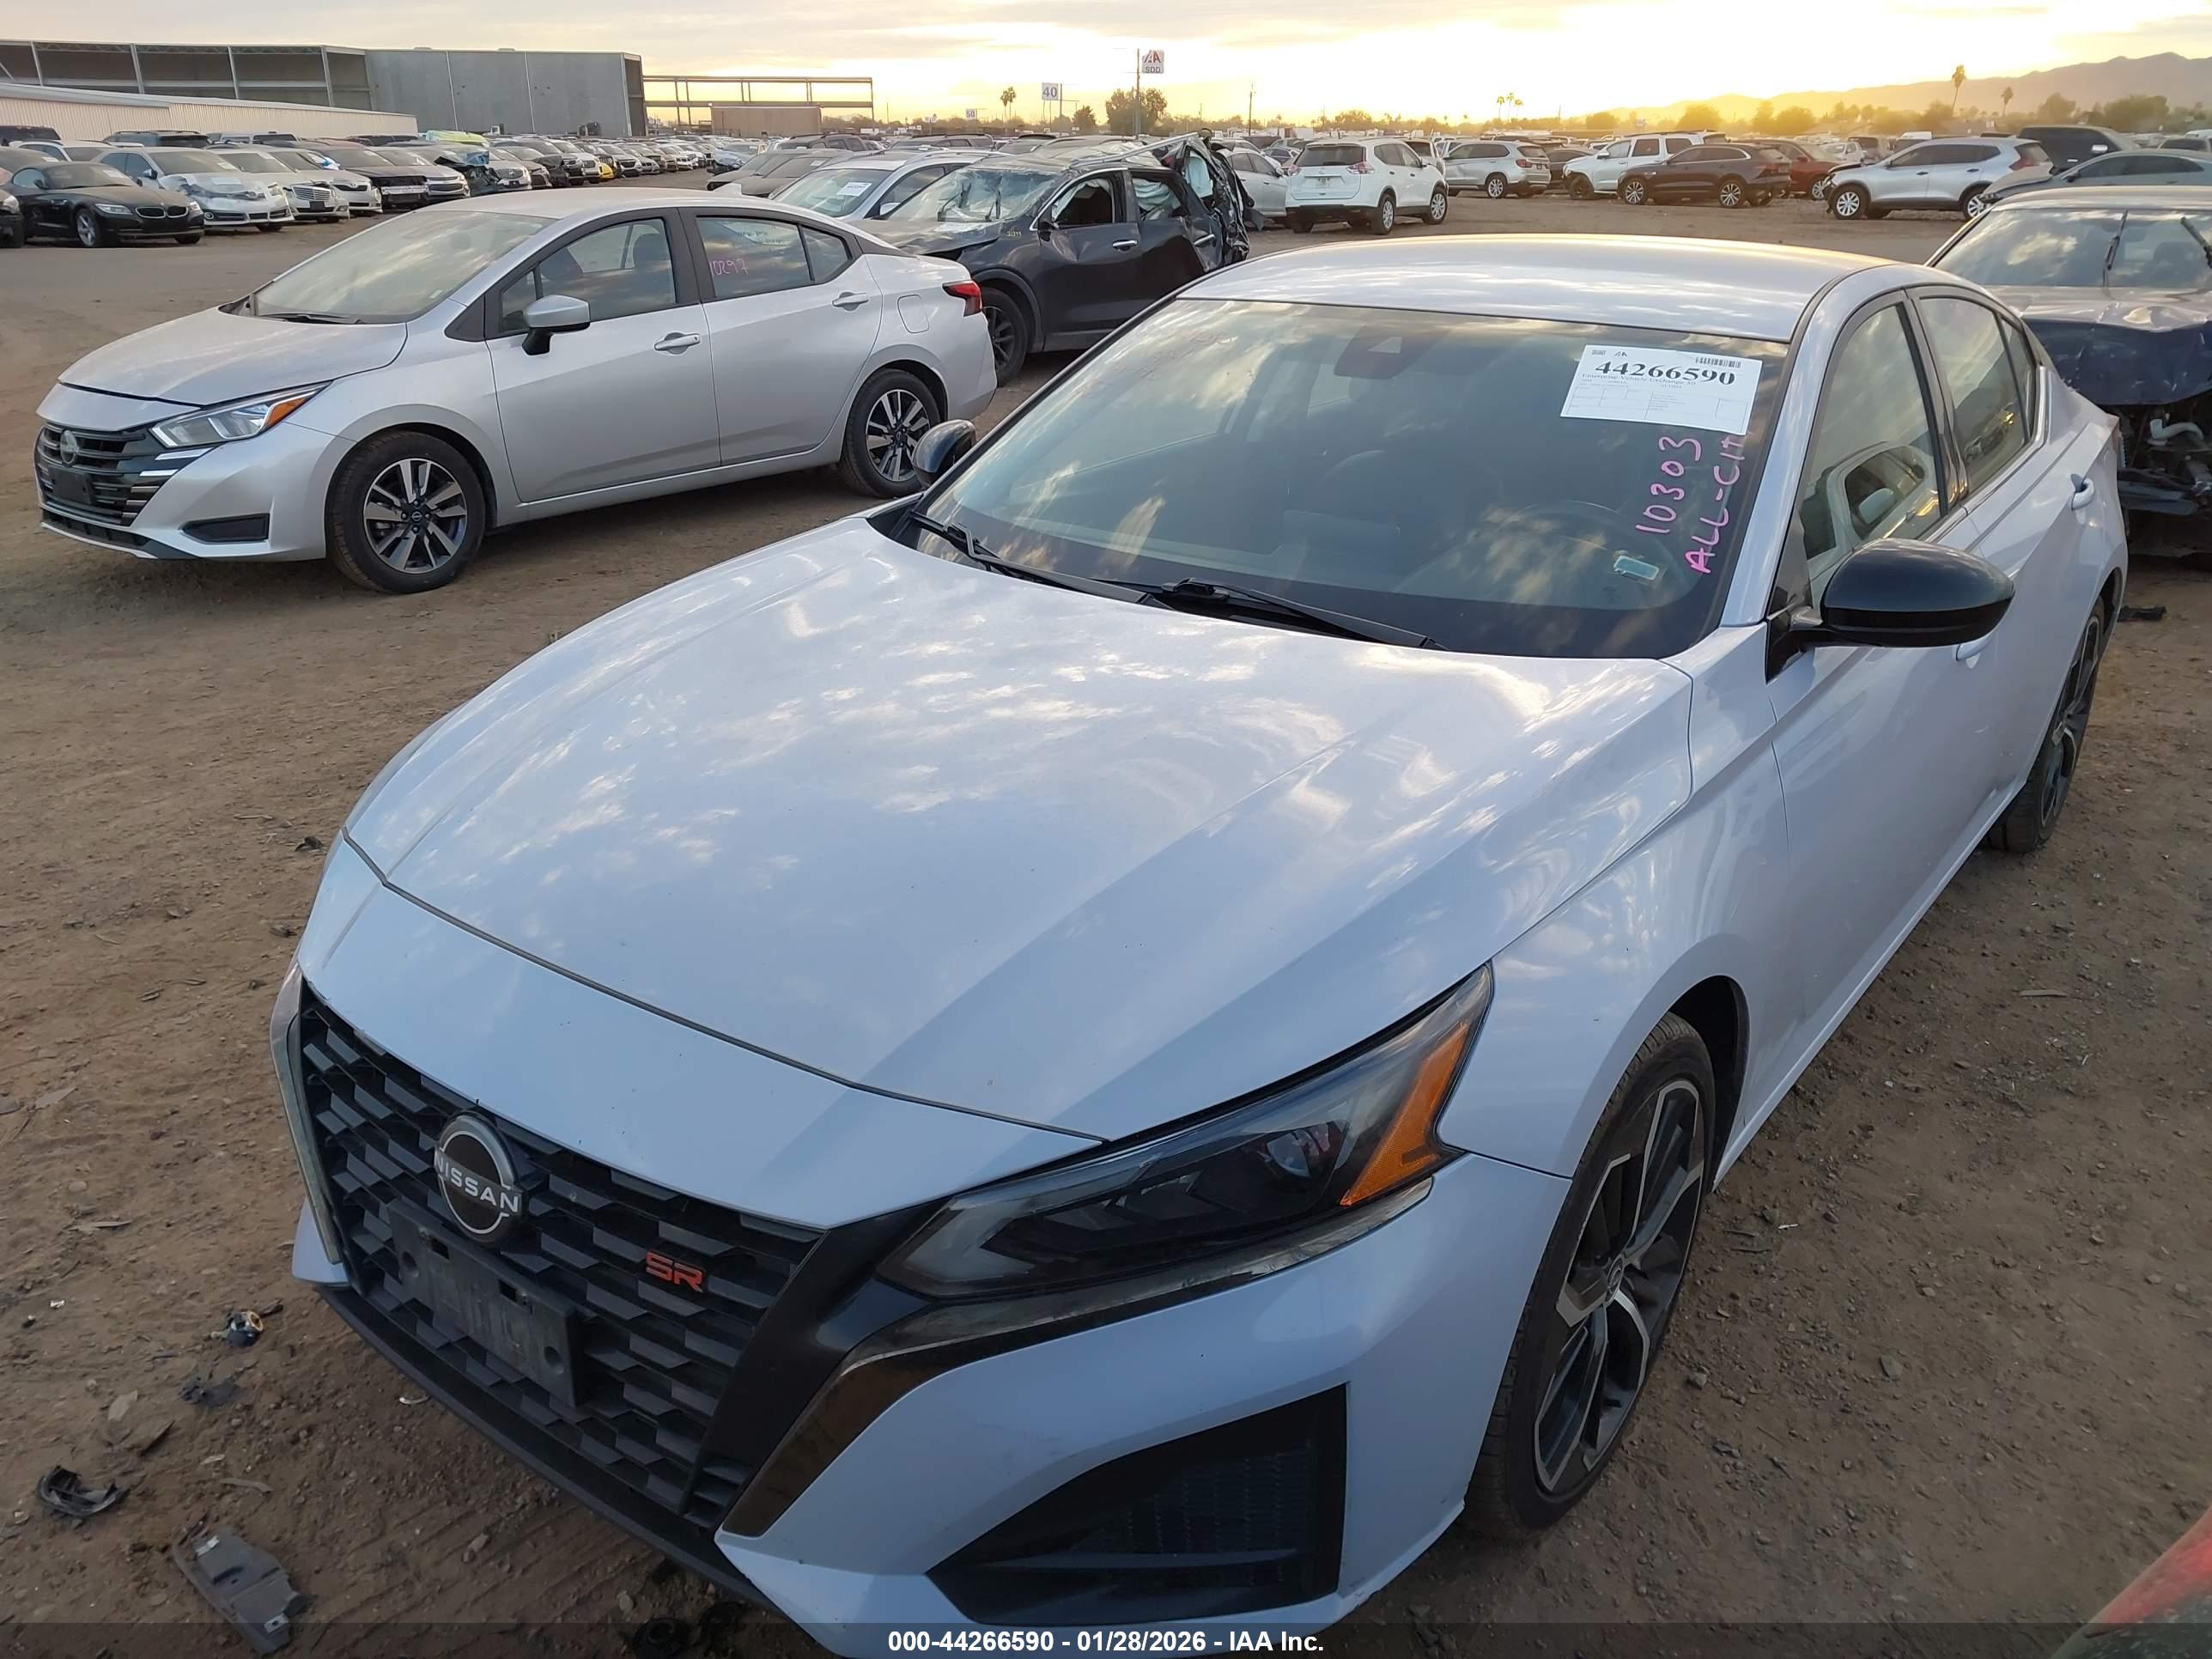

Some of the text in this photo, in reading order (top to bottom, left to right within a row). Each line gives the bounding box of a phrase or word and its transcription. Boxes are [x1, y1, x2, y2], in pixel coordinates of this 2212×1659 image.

[1042, 87, 1058, 98] 40
[1595, 361, 1735, 386] 44266590
[1635, 436, 1704, 534] 10303
[434, 1149, 519, 1212] NISSAN
[646, 1251, 703, 1292] SR
